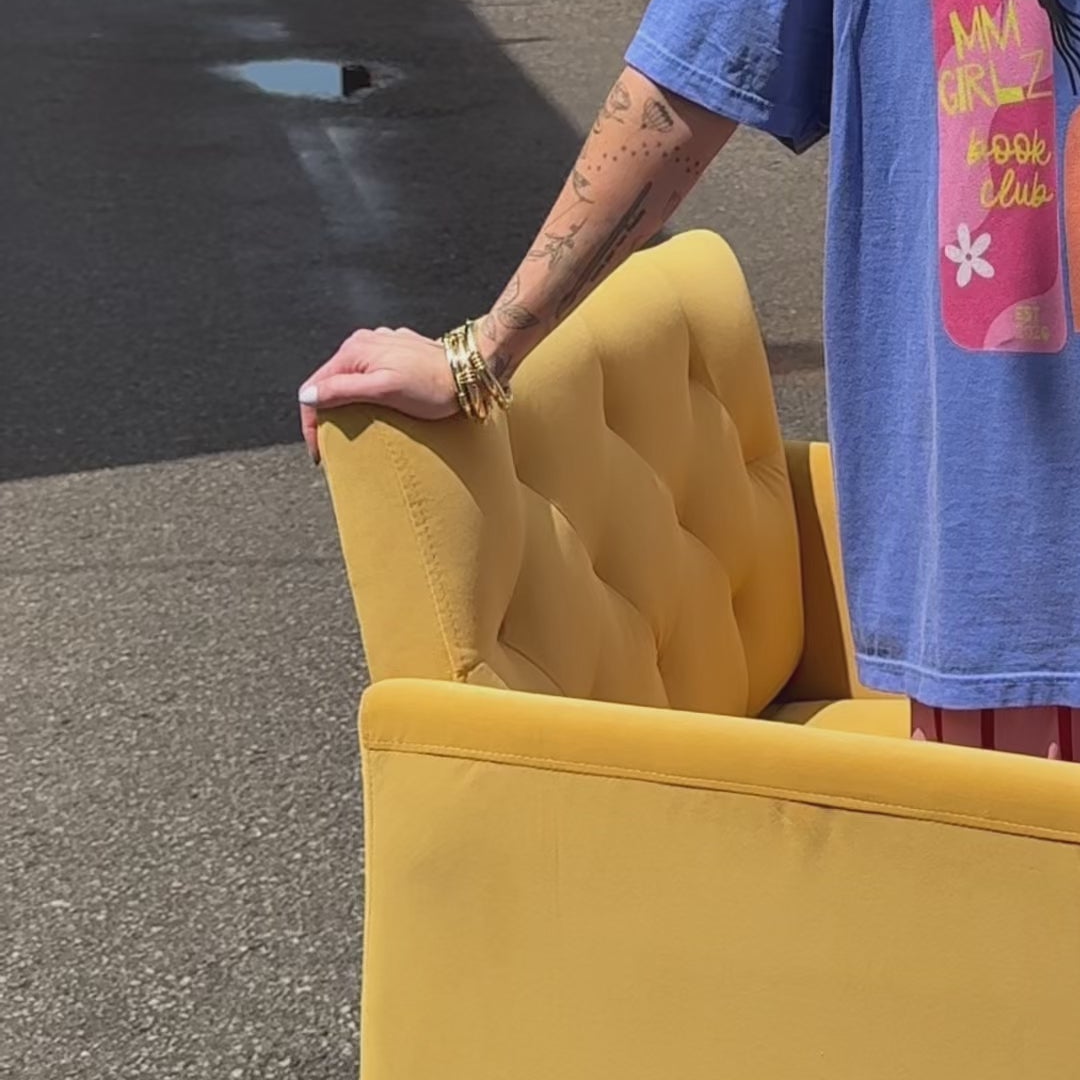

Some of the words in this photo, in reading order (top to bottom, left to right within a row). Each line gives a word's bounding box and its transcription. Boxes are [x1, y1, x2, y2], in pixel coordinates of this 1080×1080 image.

[938, 49, 1053, 115] GIRLZ
[966, 128, 1052, 166] book
[980, 168, 1054, 208] club
